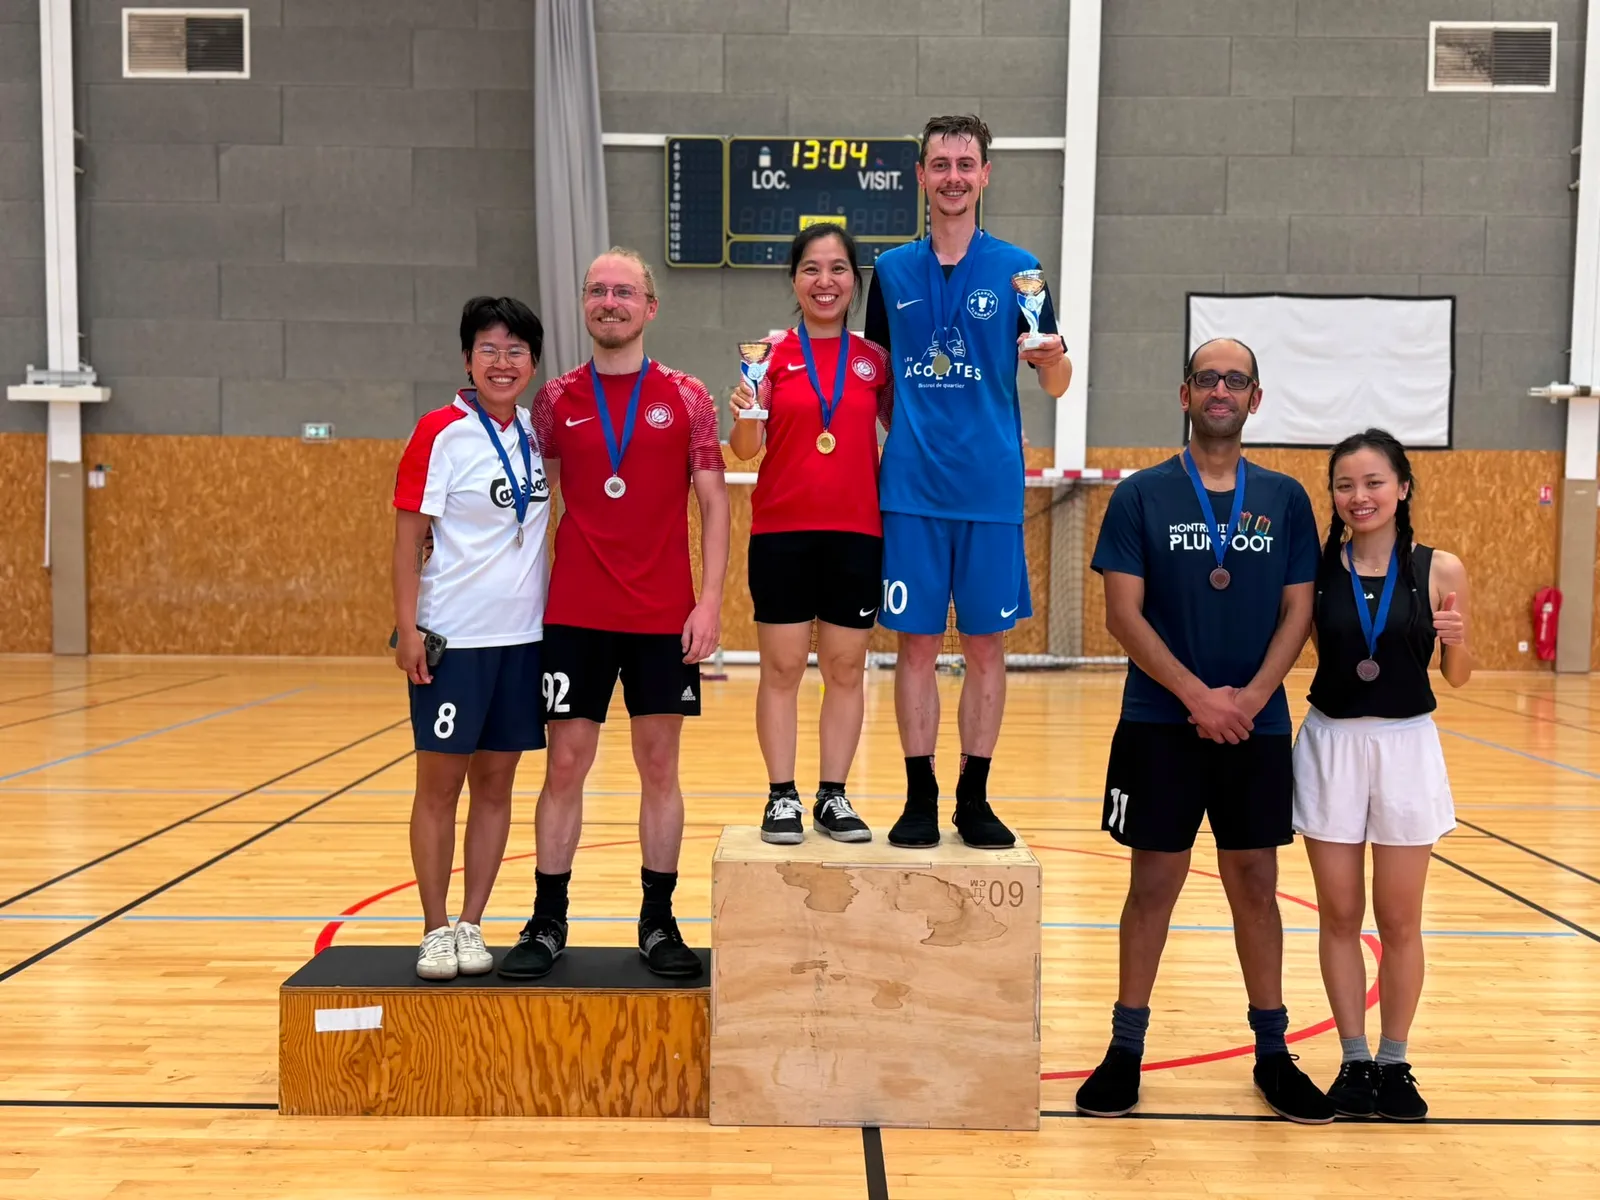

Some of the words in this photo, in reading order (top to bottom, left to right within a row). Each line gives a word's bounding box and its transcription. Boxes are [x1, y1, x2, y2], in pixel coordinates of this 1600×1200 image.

[791, 140, 868, 170] 13:04
[752, 170, 790, 189] LOC.
[857, 171, 903, 190] VISIT.
[904, 362, 982, 380] ACOYTES
[882, 579, 908, 615] 10
[542, 671, 571, 713] 92
[434, 702, 456, 739] 8
[1108, 787, 1129, 835] 11
